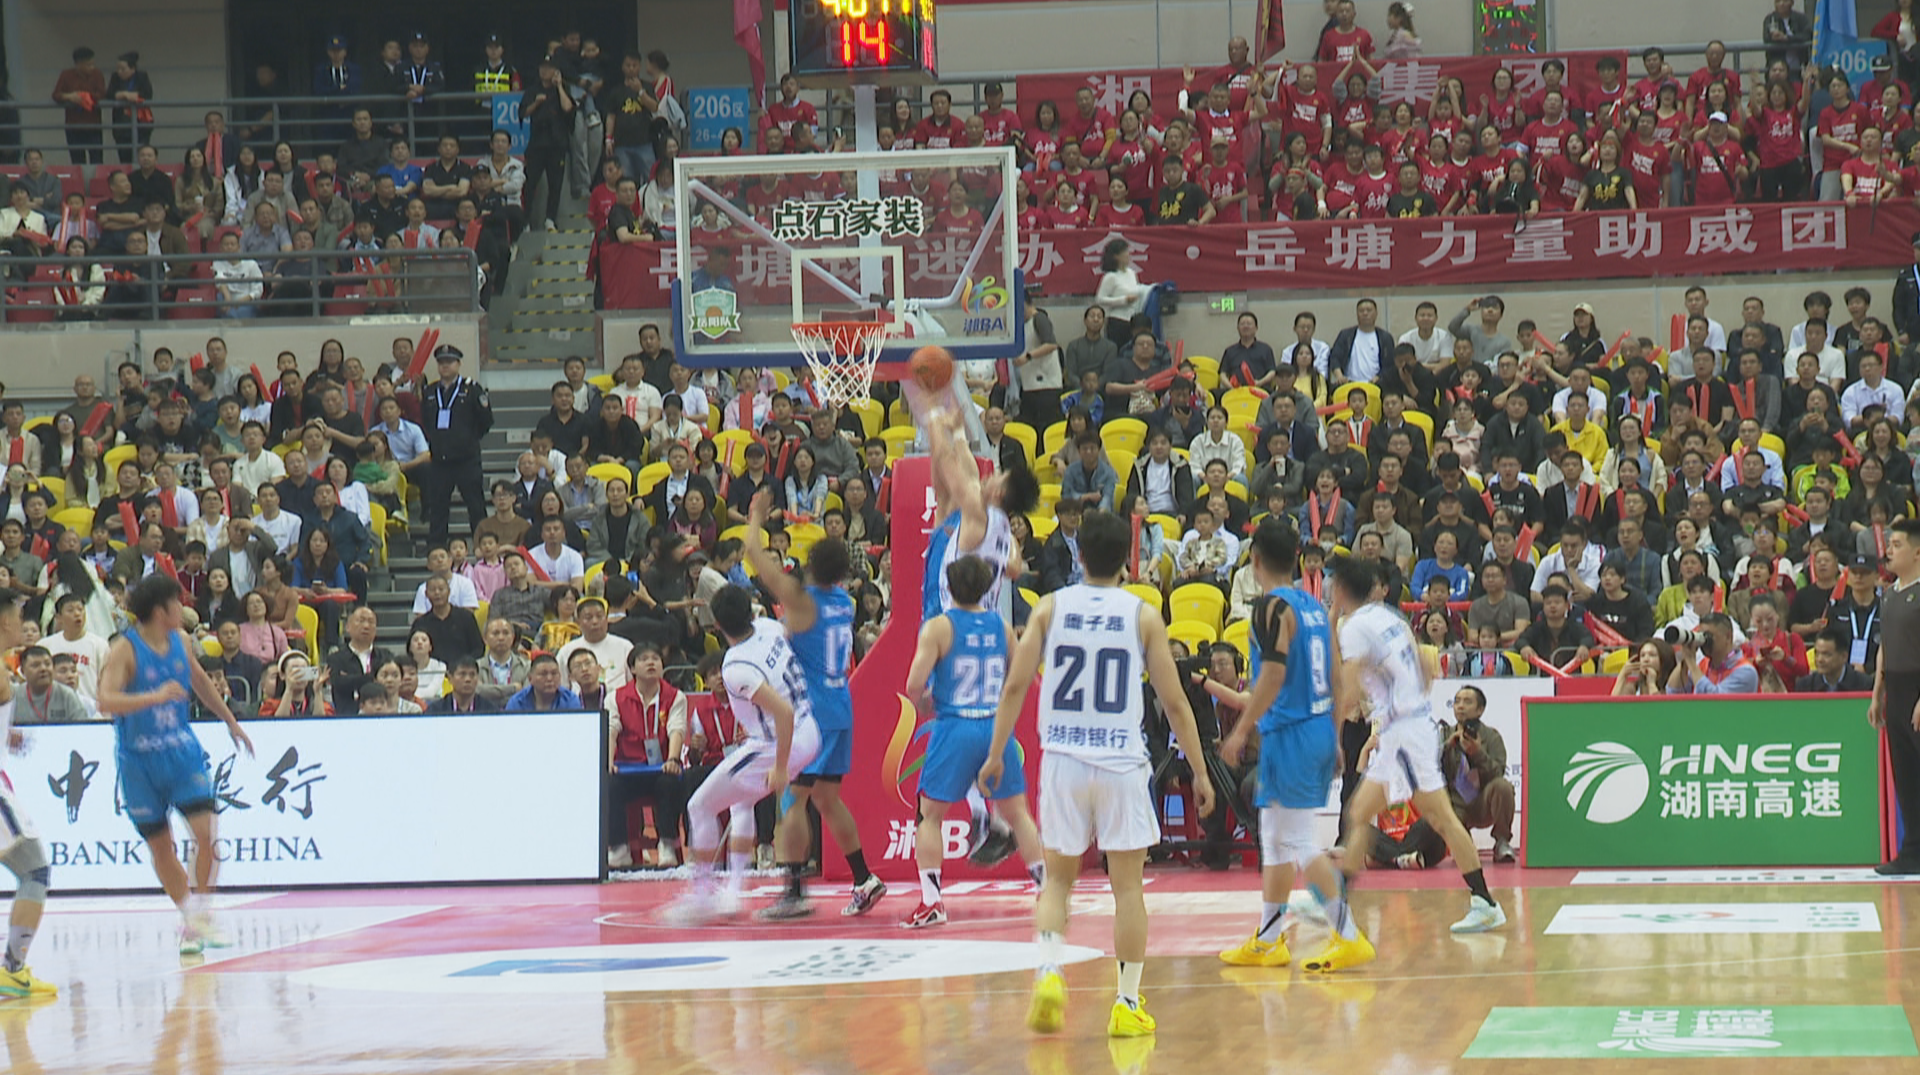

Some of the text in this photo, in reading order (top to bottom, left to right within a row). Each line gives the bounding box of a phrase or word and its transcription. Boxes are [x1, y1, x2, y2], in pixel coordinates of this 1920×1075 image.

[841, 20, 889, 64] 14
[1828, 49, 1875, 73] 206
[497, 101, 531, 124] 20
[694, 95, 745, 118] 206区
[771, 197, 924, 240] 点石家装
[952, 654, 1006, 706] 26
[1052, 644, 1131, 714] 20
[1047, 723, 1130, 749] 湖南银行
[1658, 742, 1842, 776] HNEG
[1659, 778, 1843, 820] 湖南高速
[50, 840, 145, 866] BANK
[213, 836, 323, 863] CHINA
